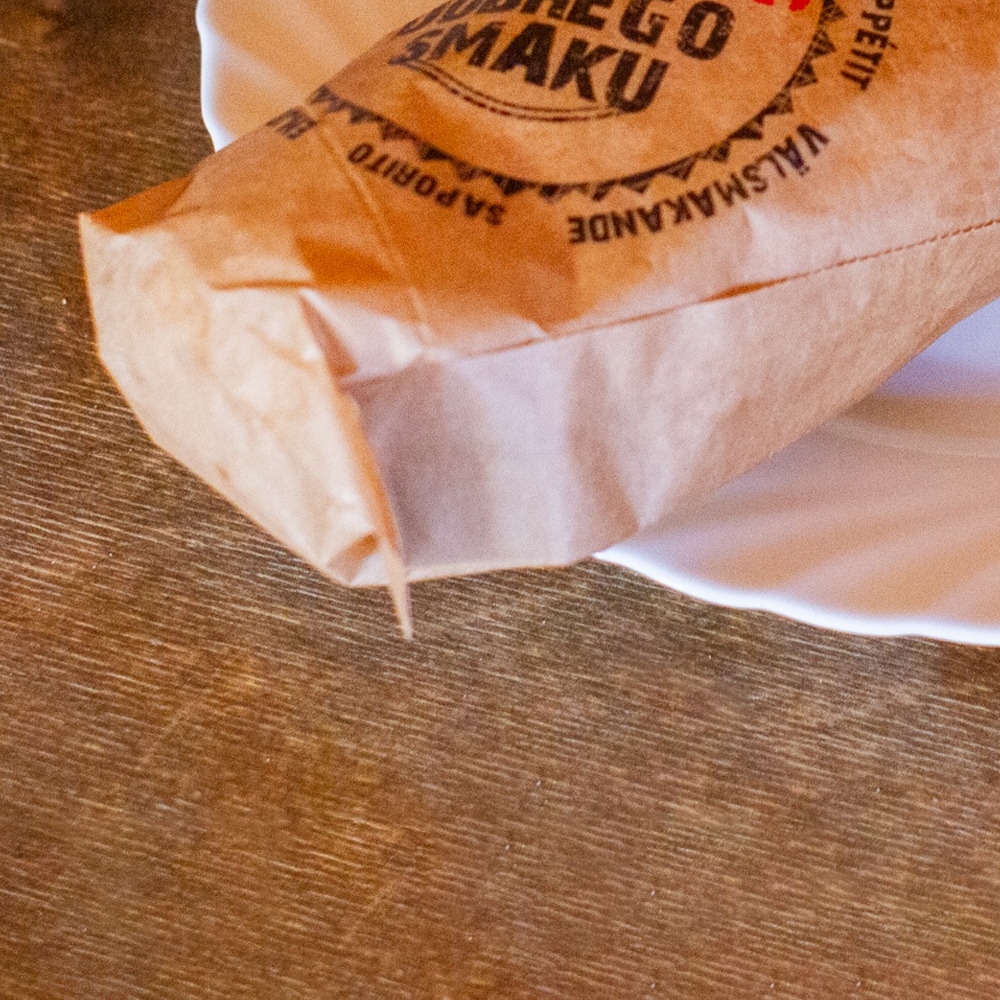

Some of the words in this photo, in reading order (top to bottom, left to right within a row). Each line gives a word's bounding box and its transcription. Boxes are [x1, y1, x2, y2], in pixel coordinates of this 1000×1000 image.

[388, 20, 670, 114] SMAKU
[347, 142, 506, 226] SAPORITO
[567, 123, 830, 245] VÄLSMAKANDE
